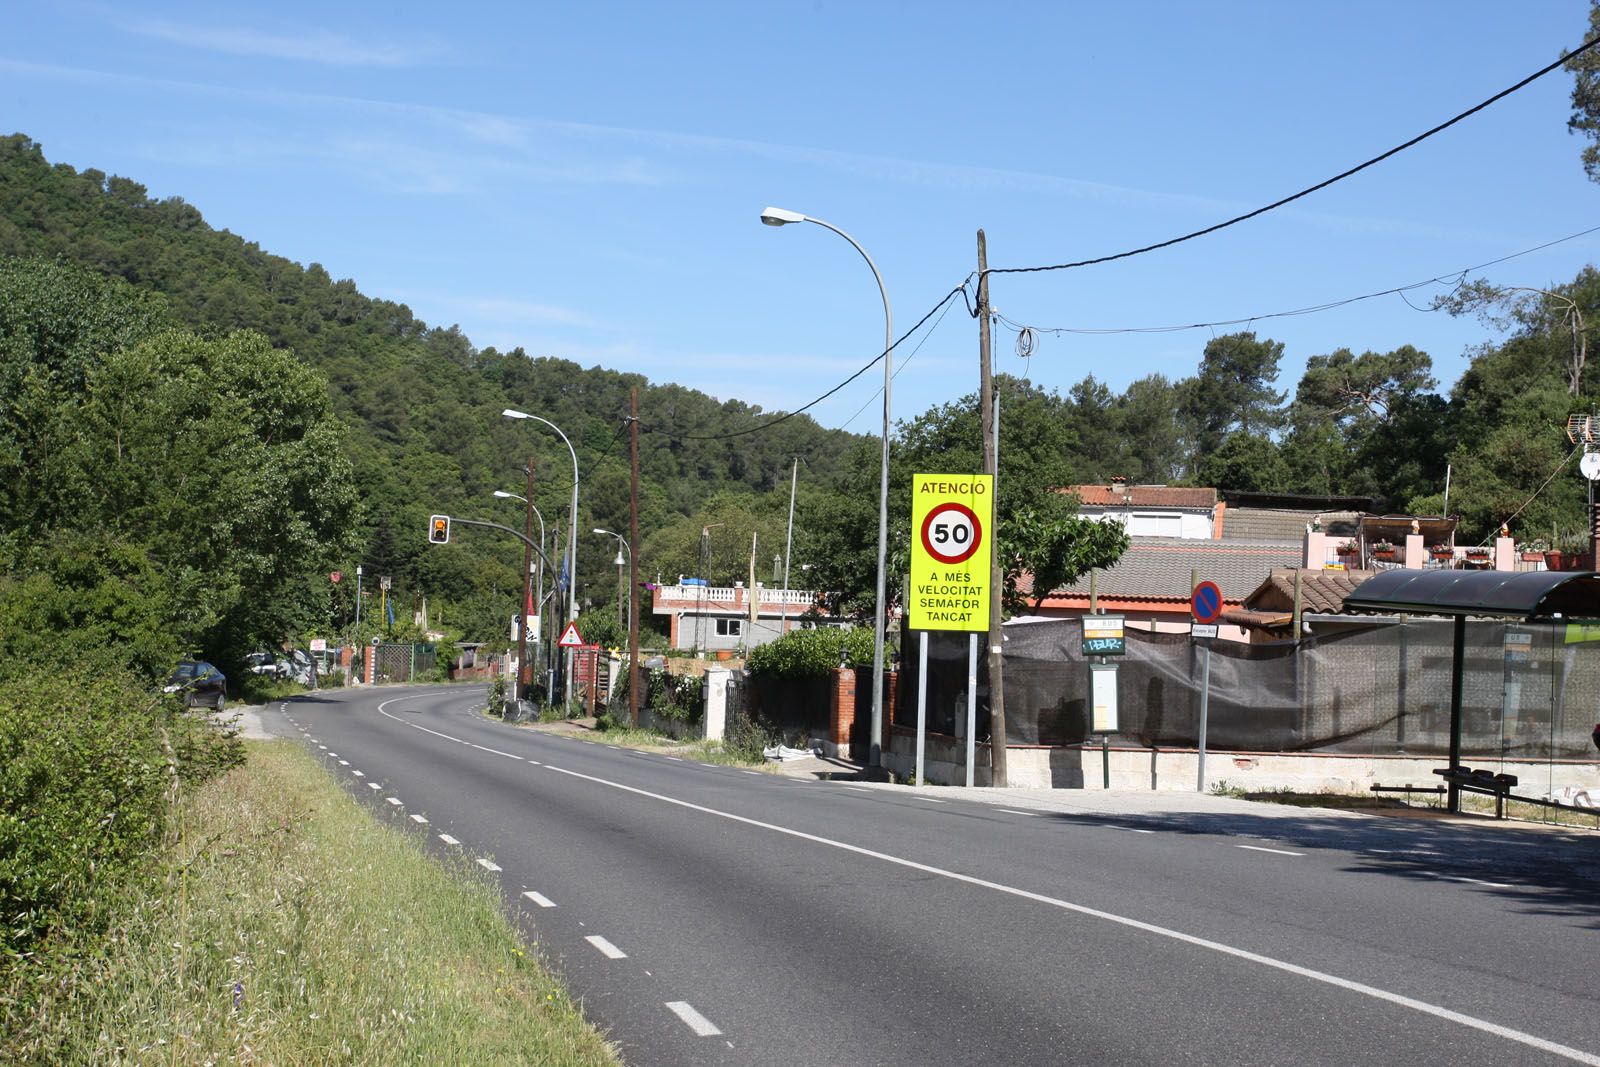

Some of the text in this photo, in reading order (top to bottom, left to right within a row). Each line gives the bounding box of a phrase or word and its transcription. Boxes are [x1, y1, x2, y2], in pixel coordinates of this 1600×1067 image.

[920, 480, 985, 495] ATENCIÓ
[934, 524, 969, 544] 50
[930, 570, 971, 583] A MÉS
[918, 585, 983, 596] VELOCITAT
[926, 611, 972, 622] TANCAT
